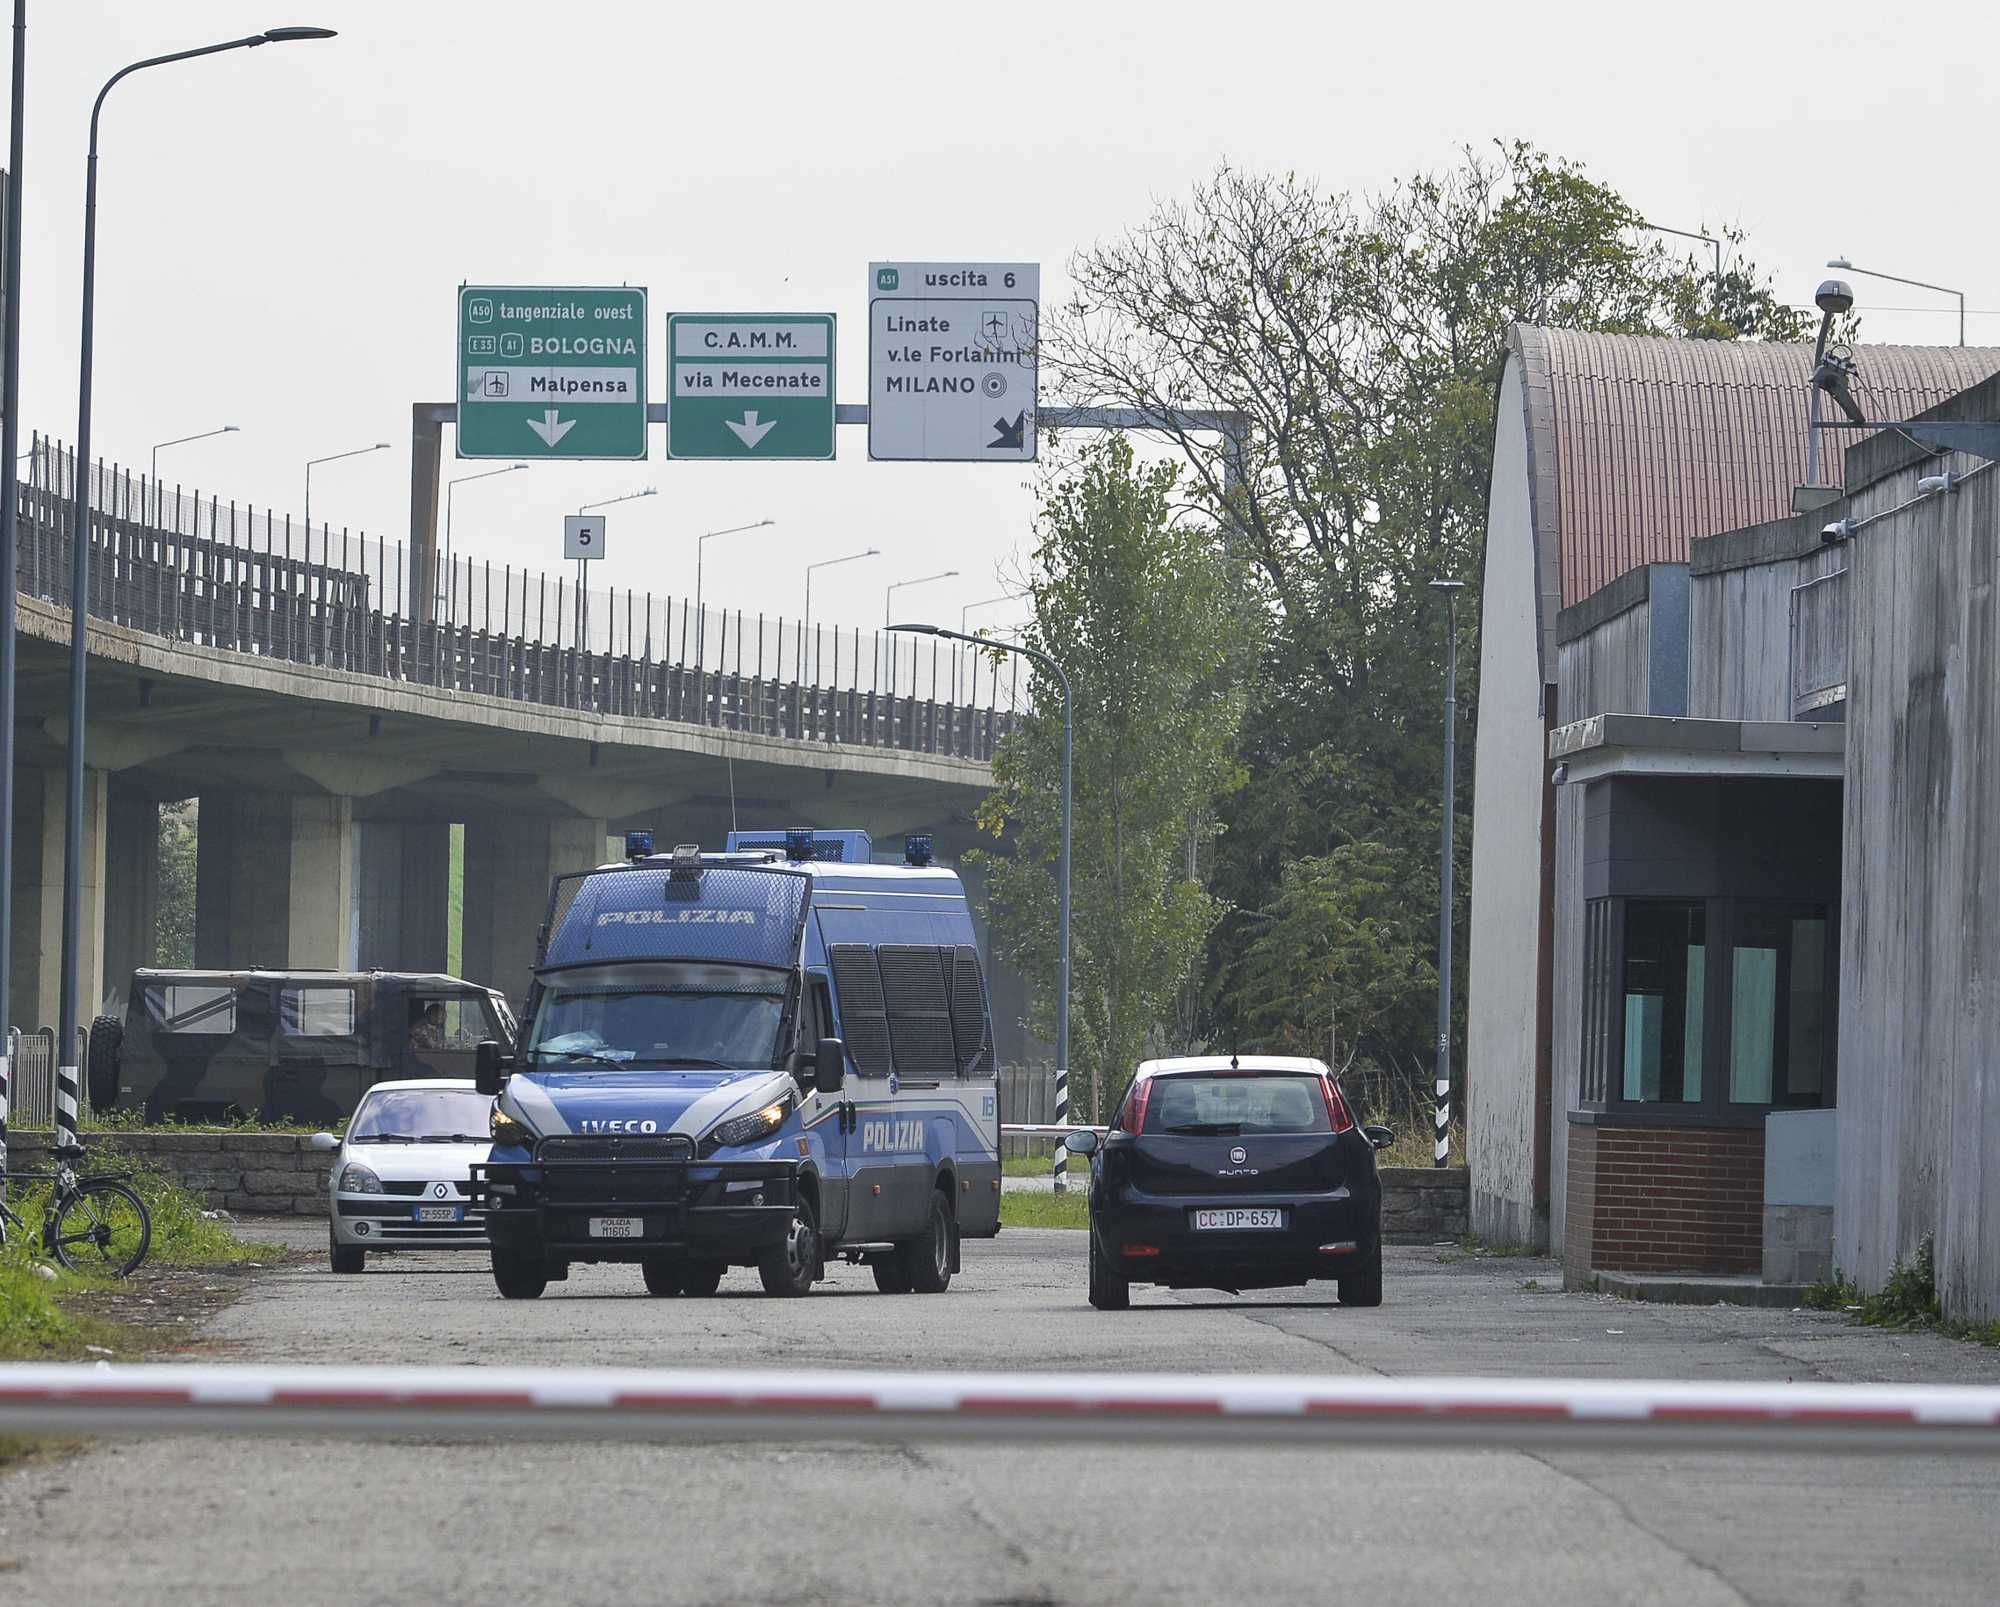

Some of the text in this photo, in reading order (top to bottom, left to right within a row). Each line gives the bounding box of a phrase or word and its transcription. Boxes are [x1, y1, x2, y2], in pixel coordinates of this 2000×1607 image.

[880, 271, 1016, 288] A51 uscita 6
[472, 302, 633, 322] A50 tangenziale ovest
[887, 316, 950, 332] Linate
[506, 339, 517, 349] A1
[530, 337, 637, 355] BOLOGNA
[704, 332, 798, 348] C.A.M.M.
[887, 347, 922, 363] v.le
[530, 376, 628, 395] Malpensa
[684, 371, 821, 388] via Mecenate
[886, 377, 975, 393] MILANO
[579, 528, 591, 545] 5
[598, 910, 755, 926] POLIZIA
[581, 1120, 657, 1134] IVECO
[863, 1119, 924, 1153] POLIZIA
[1199, 1212, 1217, 1227] CC
